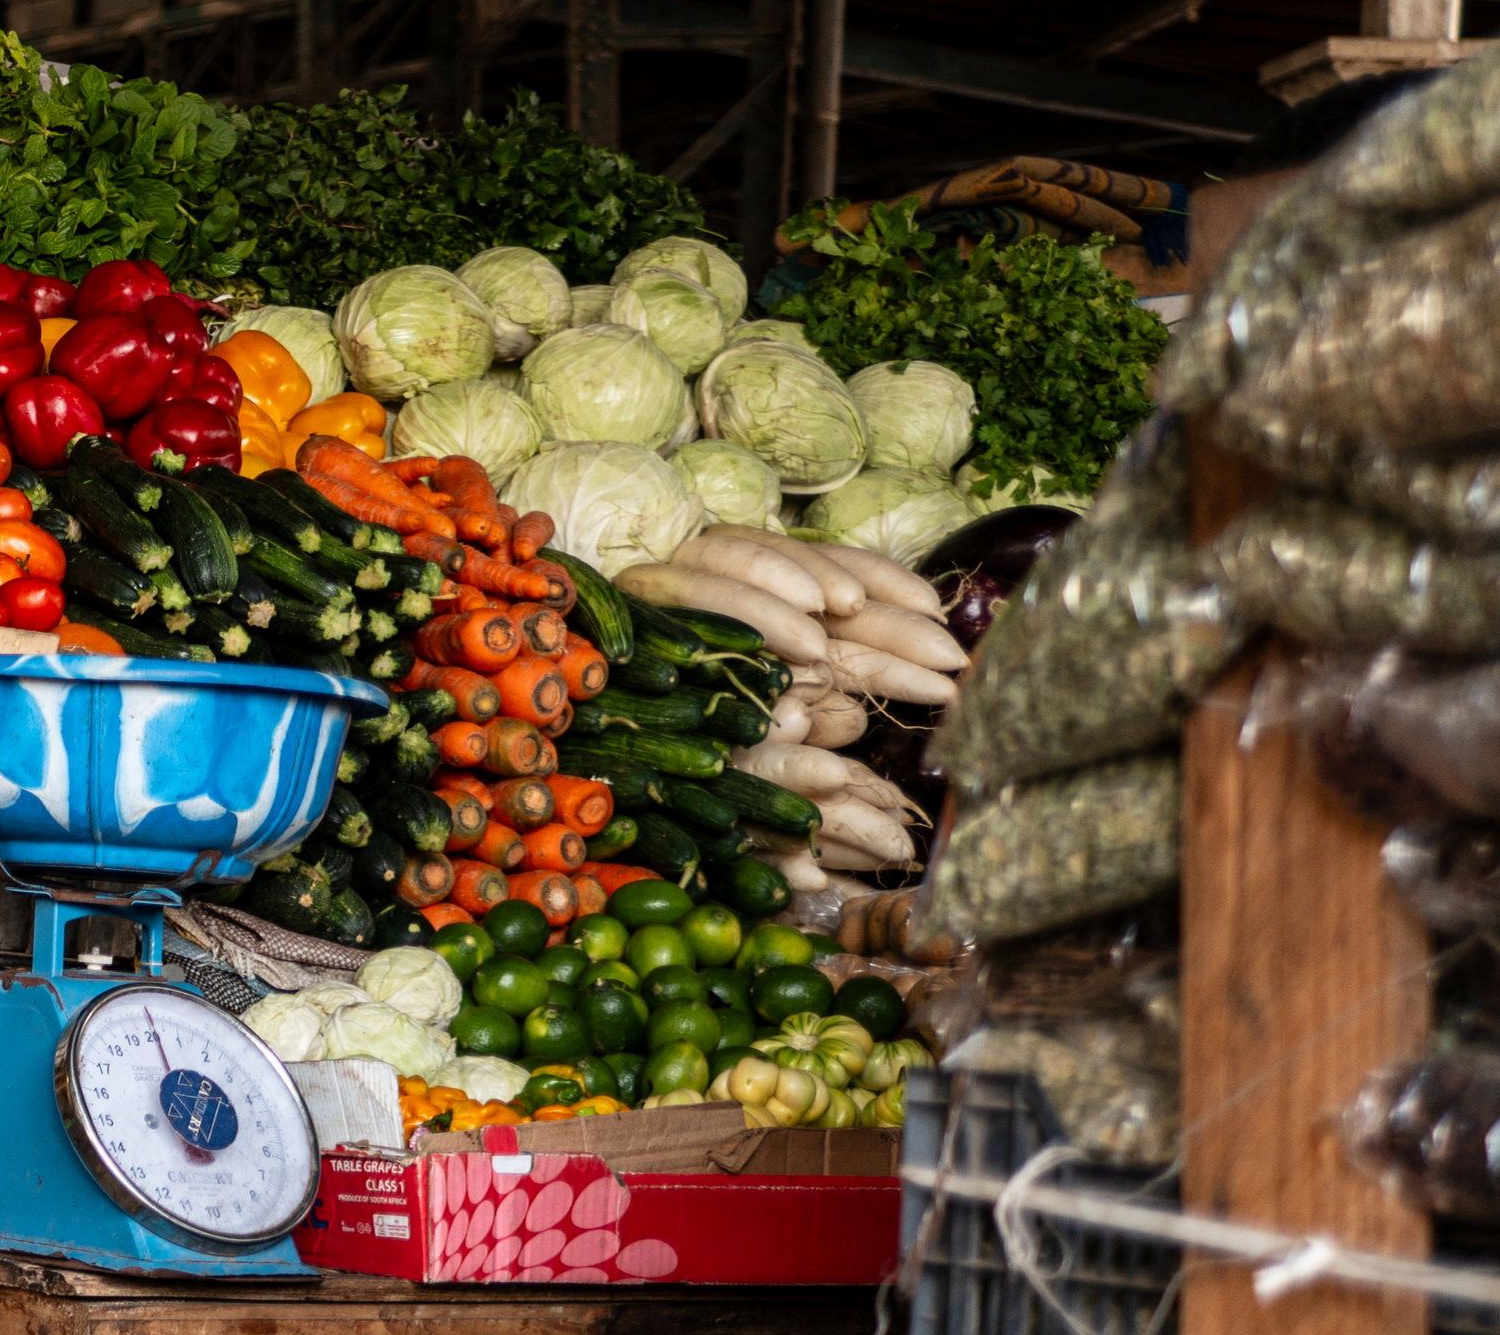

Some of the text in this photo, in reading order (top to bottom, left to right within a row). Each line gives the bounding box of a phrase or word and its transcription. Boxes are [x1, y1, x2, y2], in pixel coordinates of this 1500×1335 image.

[124, 1034, 141, 1046] 19
[176, 1037, 183, 1049] 1
[107, 1044, 124, 1058] 18
[201, 1050, 211, 1063] 2
[96, 1062, 111, 1075] 17
[226, 1071, 234, 1083] 3
[93, 1086, 110, 1100] 16
[245, 1094, 254, 1105] 4
[98, 1113, 114, 1127] 15
[256, 1121, 265, 1134] 5
[110, 1140, 126, 1153] 14
[261, 1146, 271, 1158] 6
[129, 1166, 146, 1179] 13
[331, 1160, 404, 1174] TABLE GRAPES
[258, 1169, 266, 1181] 7
[365, 1178, 405, 1193] CLASS 1
[155, 1187, 171, 1201] 12
[250, 1189, 259, 1201] 8
[338, 1193, 408, 1205] PRODUCE OF SOUTH AFRICA
[179, 1199, 193, 1211] 11
[204, 1204, 221, 1218] 10
[234, 1201, 242, 1213] 9
